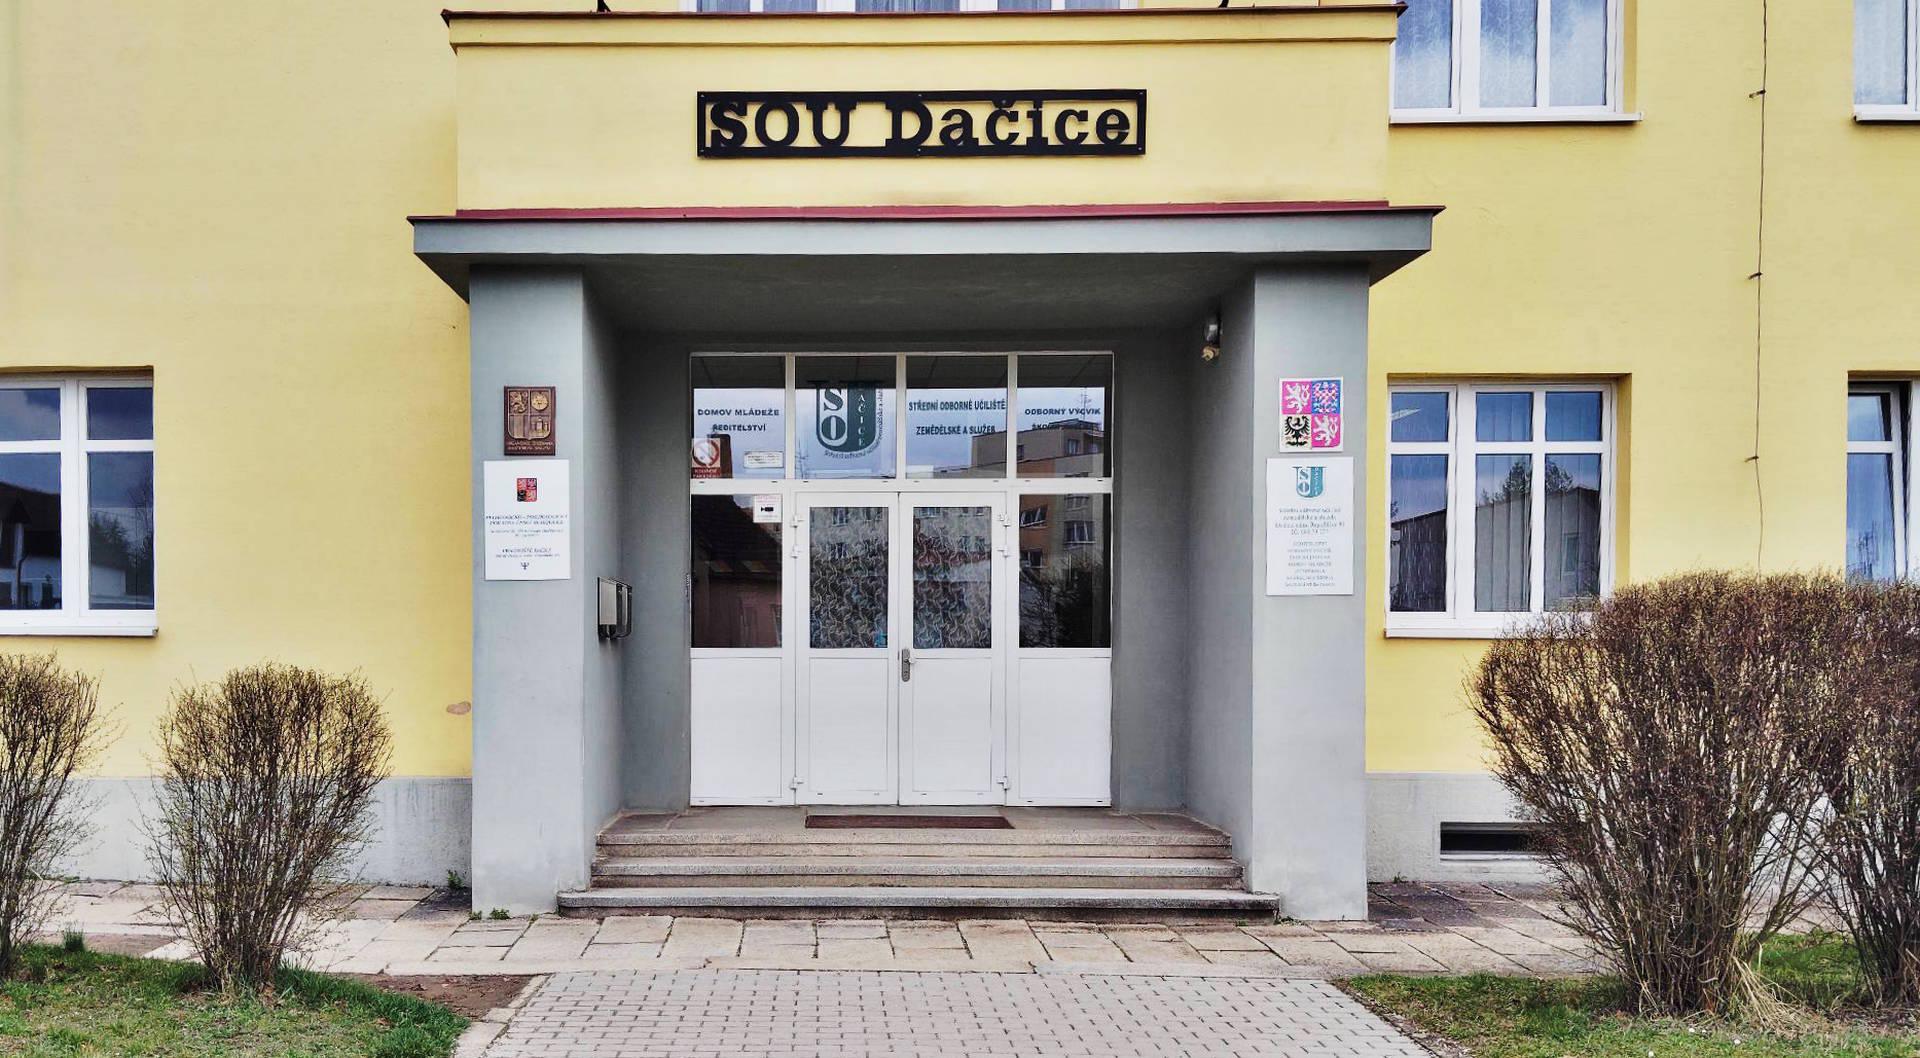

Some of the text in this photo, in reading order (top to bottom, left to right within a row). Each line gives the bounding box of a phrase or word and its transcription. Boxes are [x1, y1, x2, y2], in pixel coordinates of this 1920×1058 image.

[710, 99, 1132, 148] SOU Dačice
[908, 398, 1006, 411] STŘEDNÍ ODBORNÉ UČILIŠTĚ
[697, 407, 780, 416] DOMOV MLÁDEŽE
[1024, 407, 1101, 415] ODBORNÝ VÝCVIK
[712, 422, 766, 431] ŘEDITELSTVÍ
[916, 423, 996, 435] ZEMĚDĚLSKÉ A SLUŽEB
